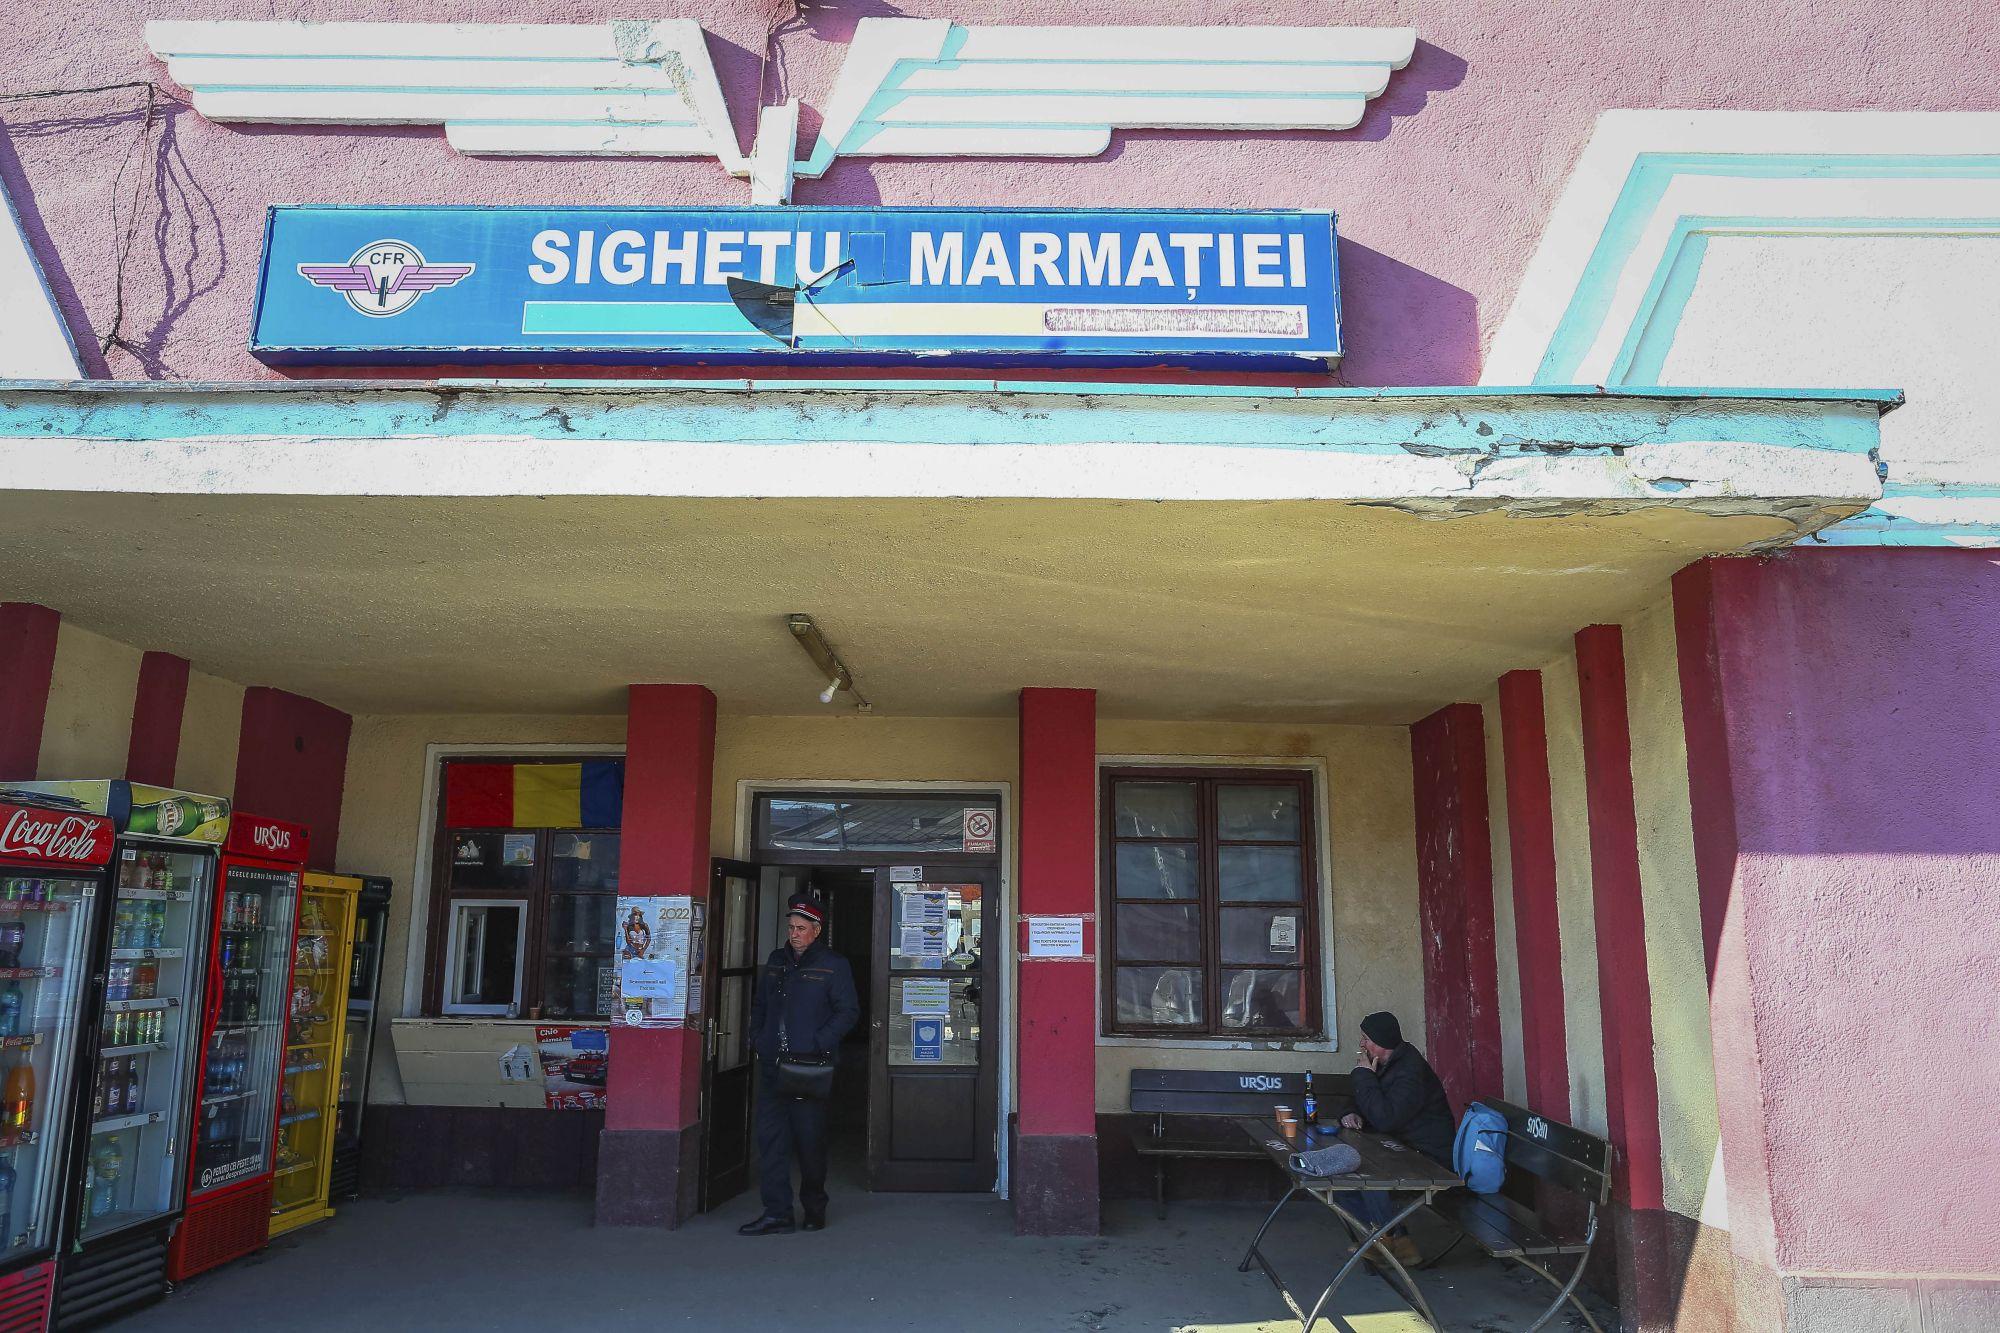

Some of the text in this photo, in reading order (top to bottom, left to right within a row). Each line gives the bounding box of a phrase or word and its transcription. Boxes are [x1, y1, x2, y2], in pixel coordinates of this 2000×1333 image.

[369, 252, 405, 267] CFR
[528, 230, 1307, 301] SIGHETU MARMAȚIEI
[0, 809, 100, 859] Coca-Cola
[254, 826, 290, 850] URSUS
[659, 908, 690, 920] 2022
[540, 1028, 558, 1036] Chio
[1239, 1075, 1282, 1091] URSUS
